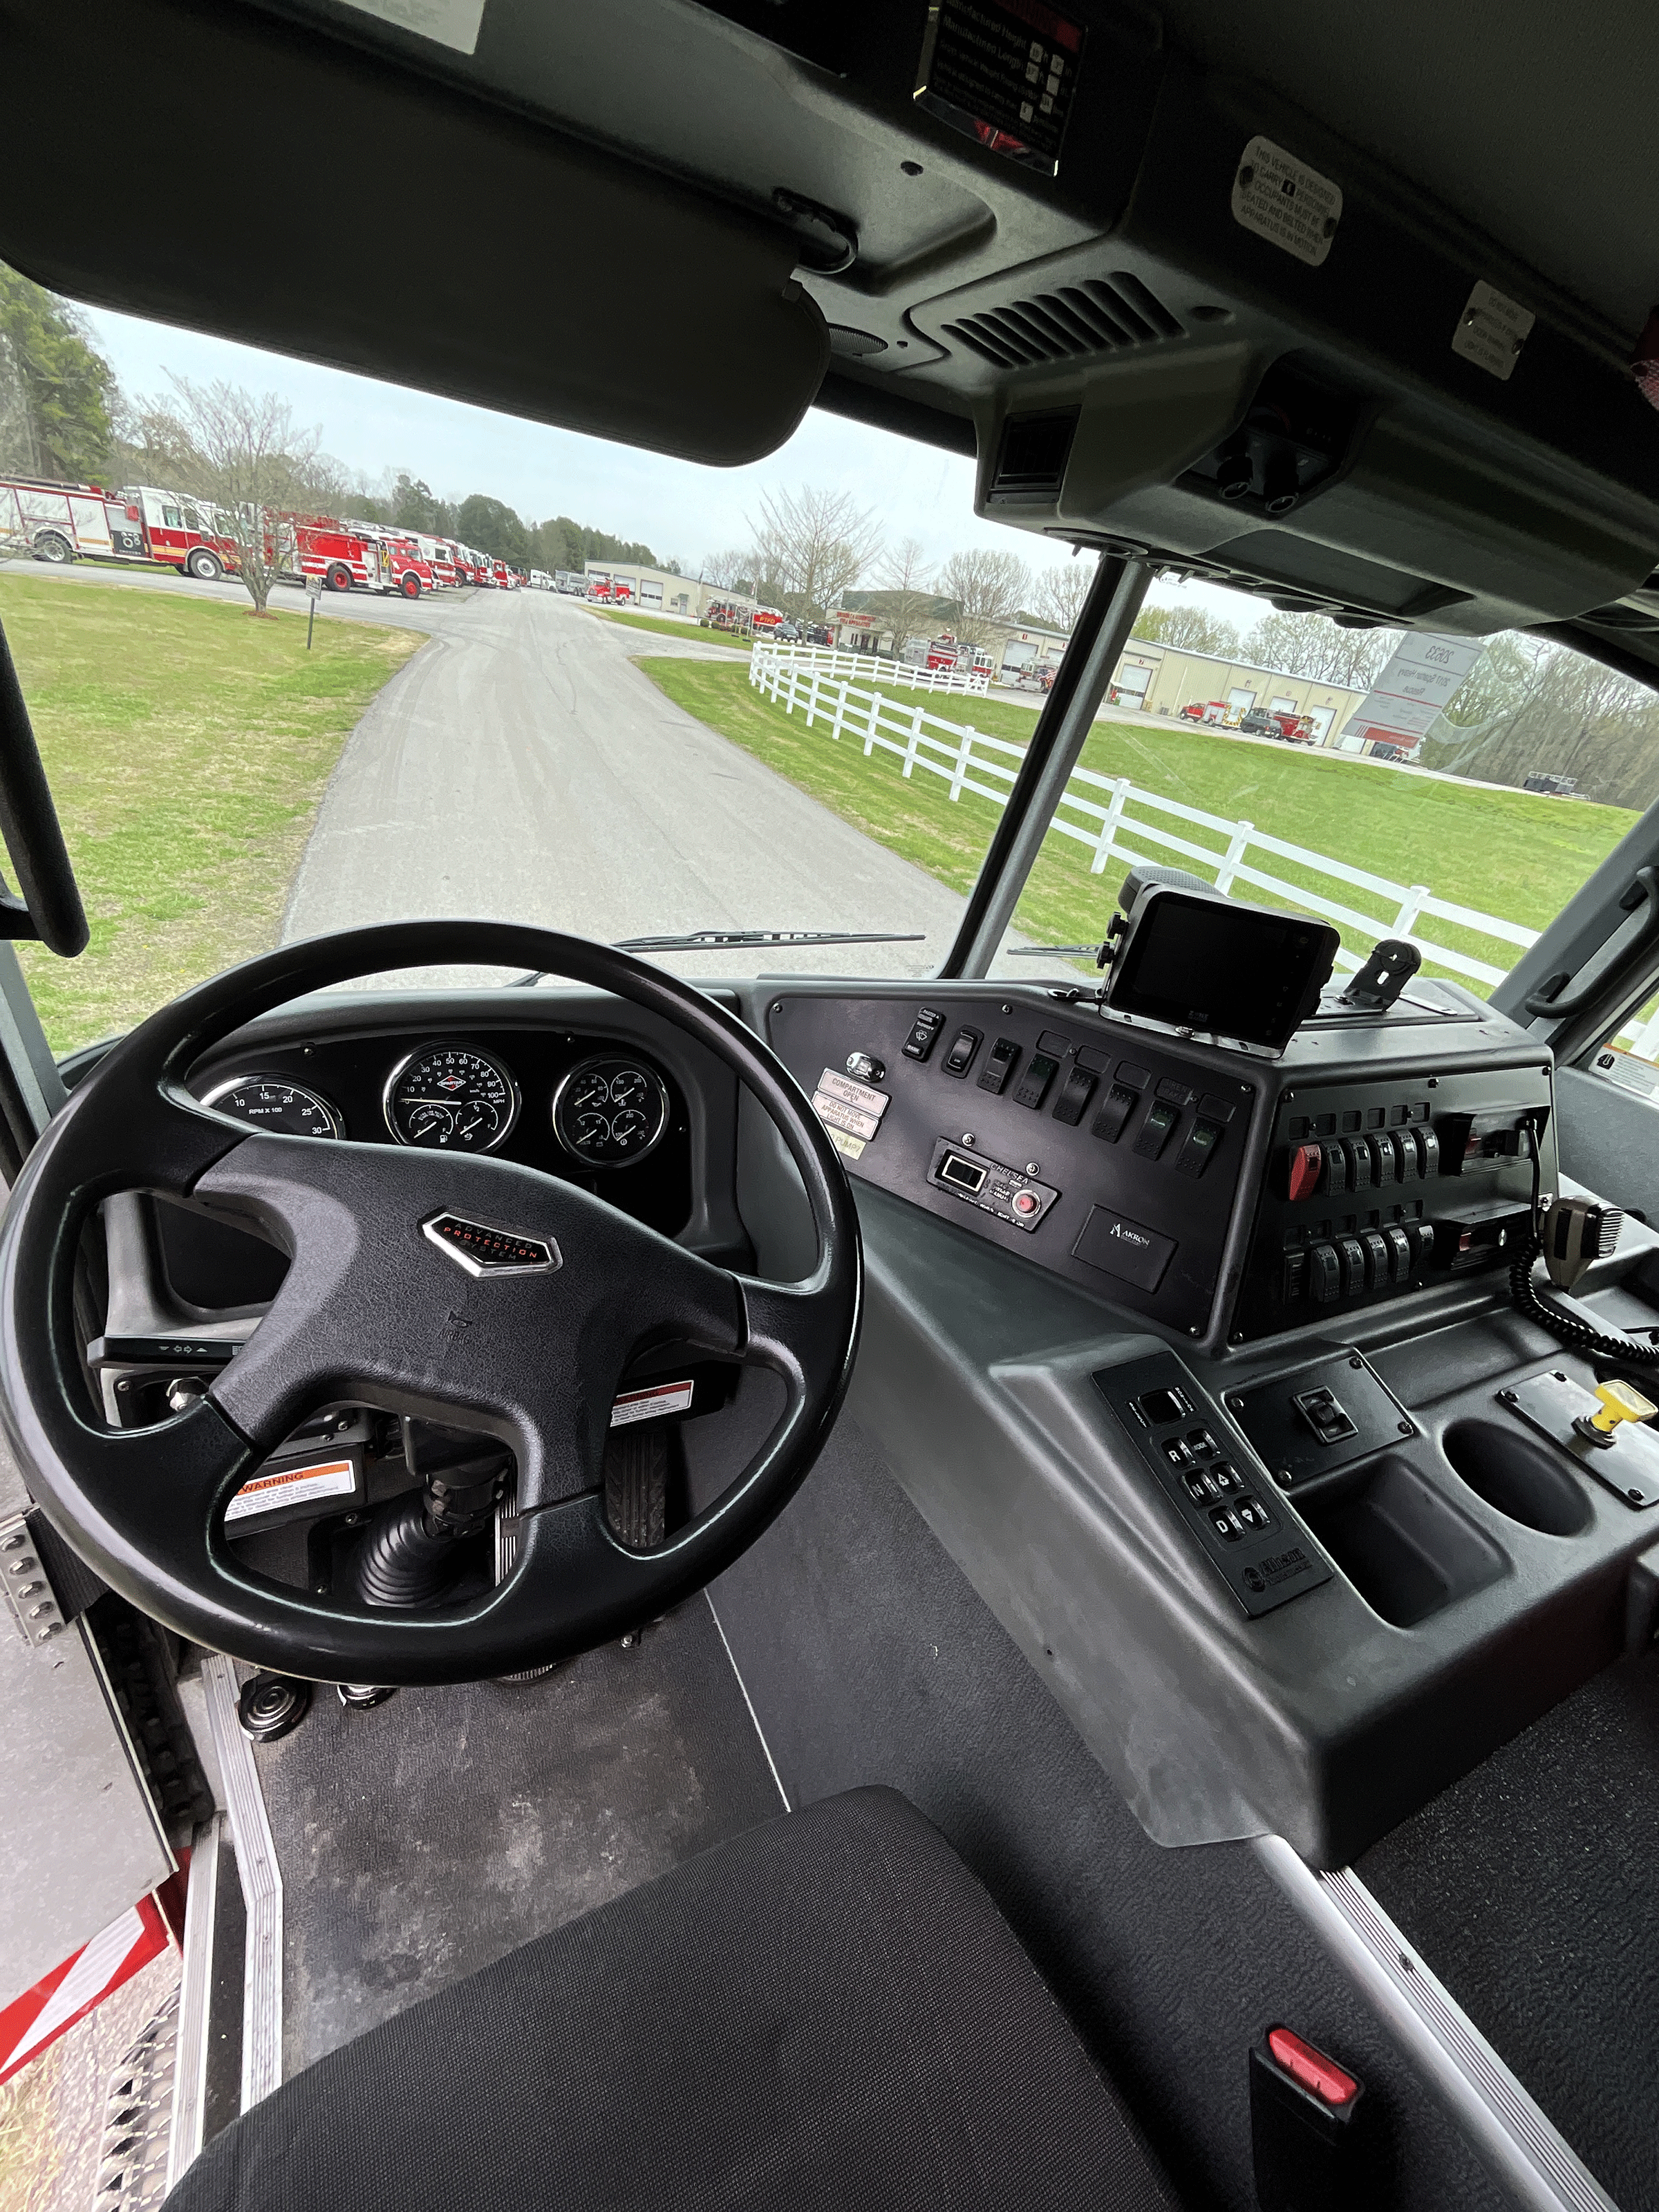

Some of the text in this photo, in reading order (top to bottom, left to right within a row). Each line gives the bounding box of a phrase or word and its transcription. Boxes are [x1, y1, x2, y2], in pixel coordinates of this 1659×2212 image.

[832, 1078, 877, 1102] COMPARTMENT
[843, 1090, 859, 1102] OPEN
[821, 1105, 865, 1128] APPARATUS WHEN
[838, 1105, 847, 1113] NOT
[848, 1109, 861, 1120] MOVE
[827, 1114, 841, 1125] LIGHT
[847, 1122, 854, 1130] ON
[991, 1163, 1029, 1185] CHELSEA
[444, 1226, 537, 1258] PROTECTION
[455, 1223, 533, 1249] ADVANCED
[1122, 1230, 1150, 1245] AKRON
[459, 1239, 516, 1260] SYSTEM
[1168, 1450, 1181, 1462] R
[242, 1472, 304, 1492] WARNING
[1191, 1483, 1204, 1497] N
[1216, 1520, 1228, 1533] D
